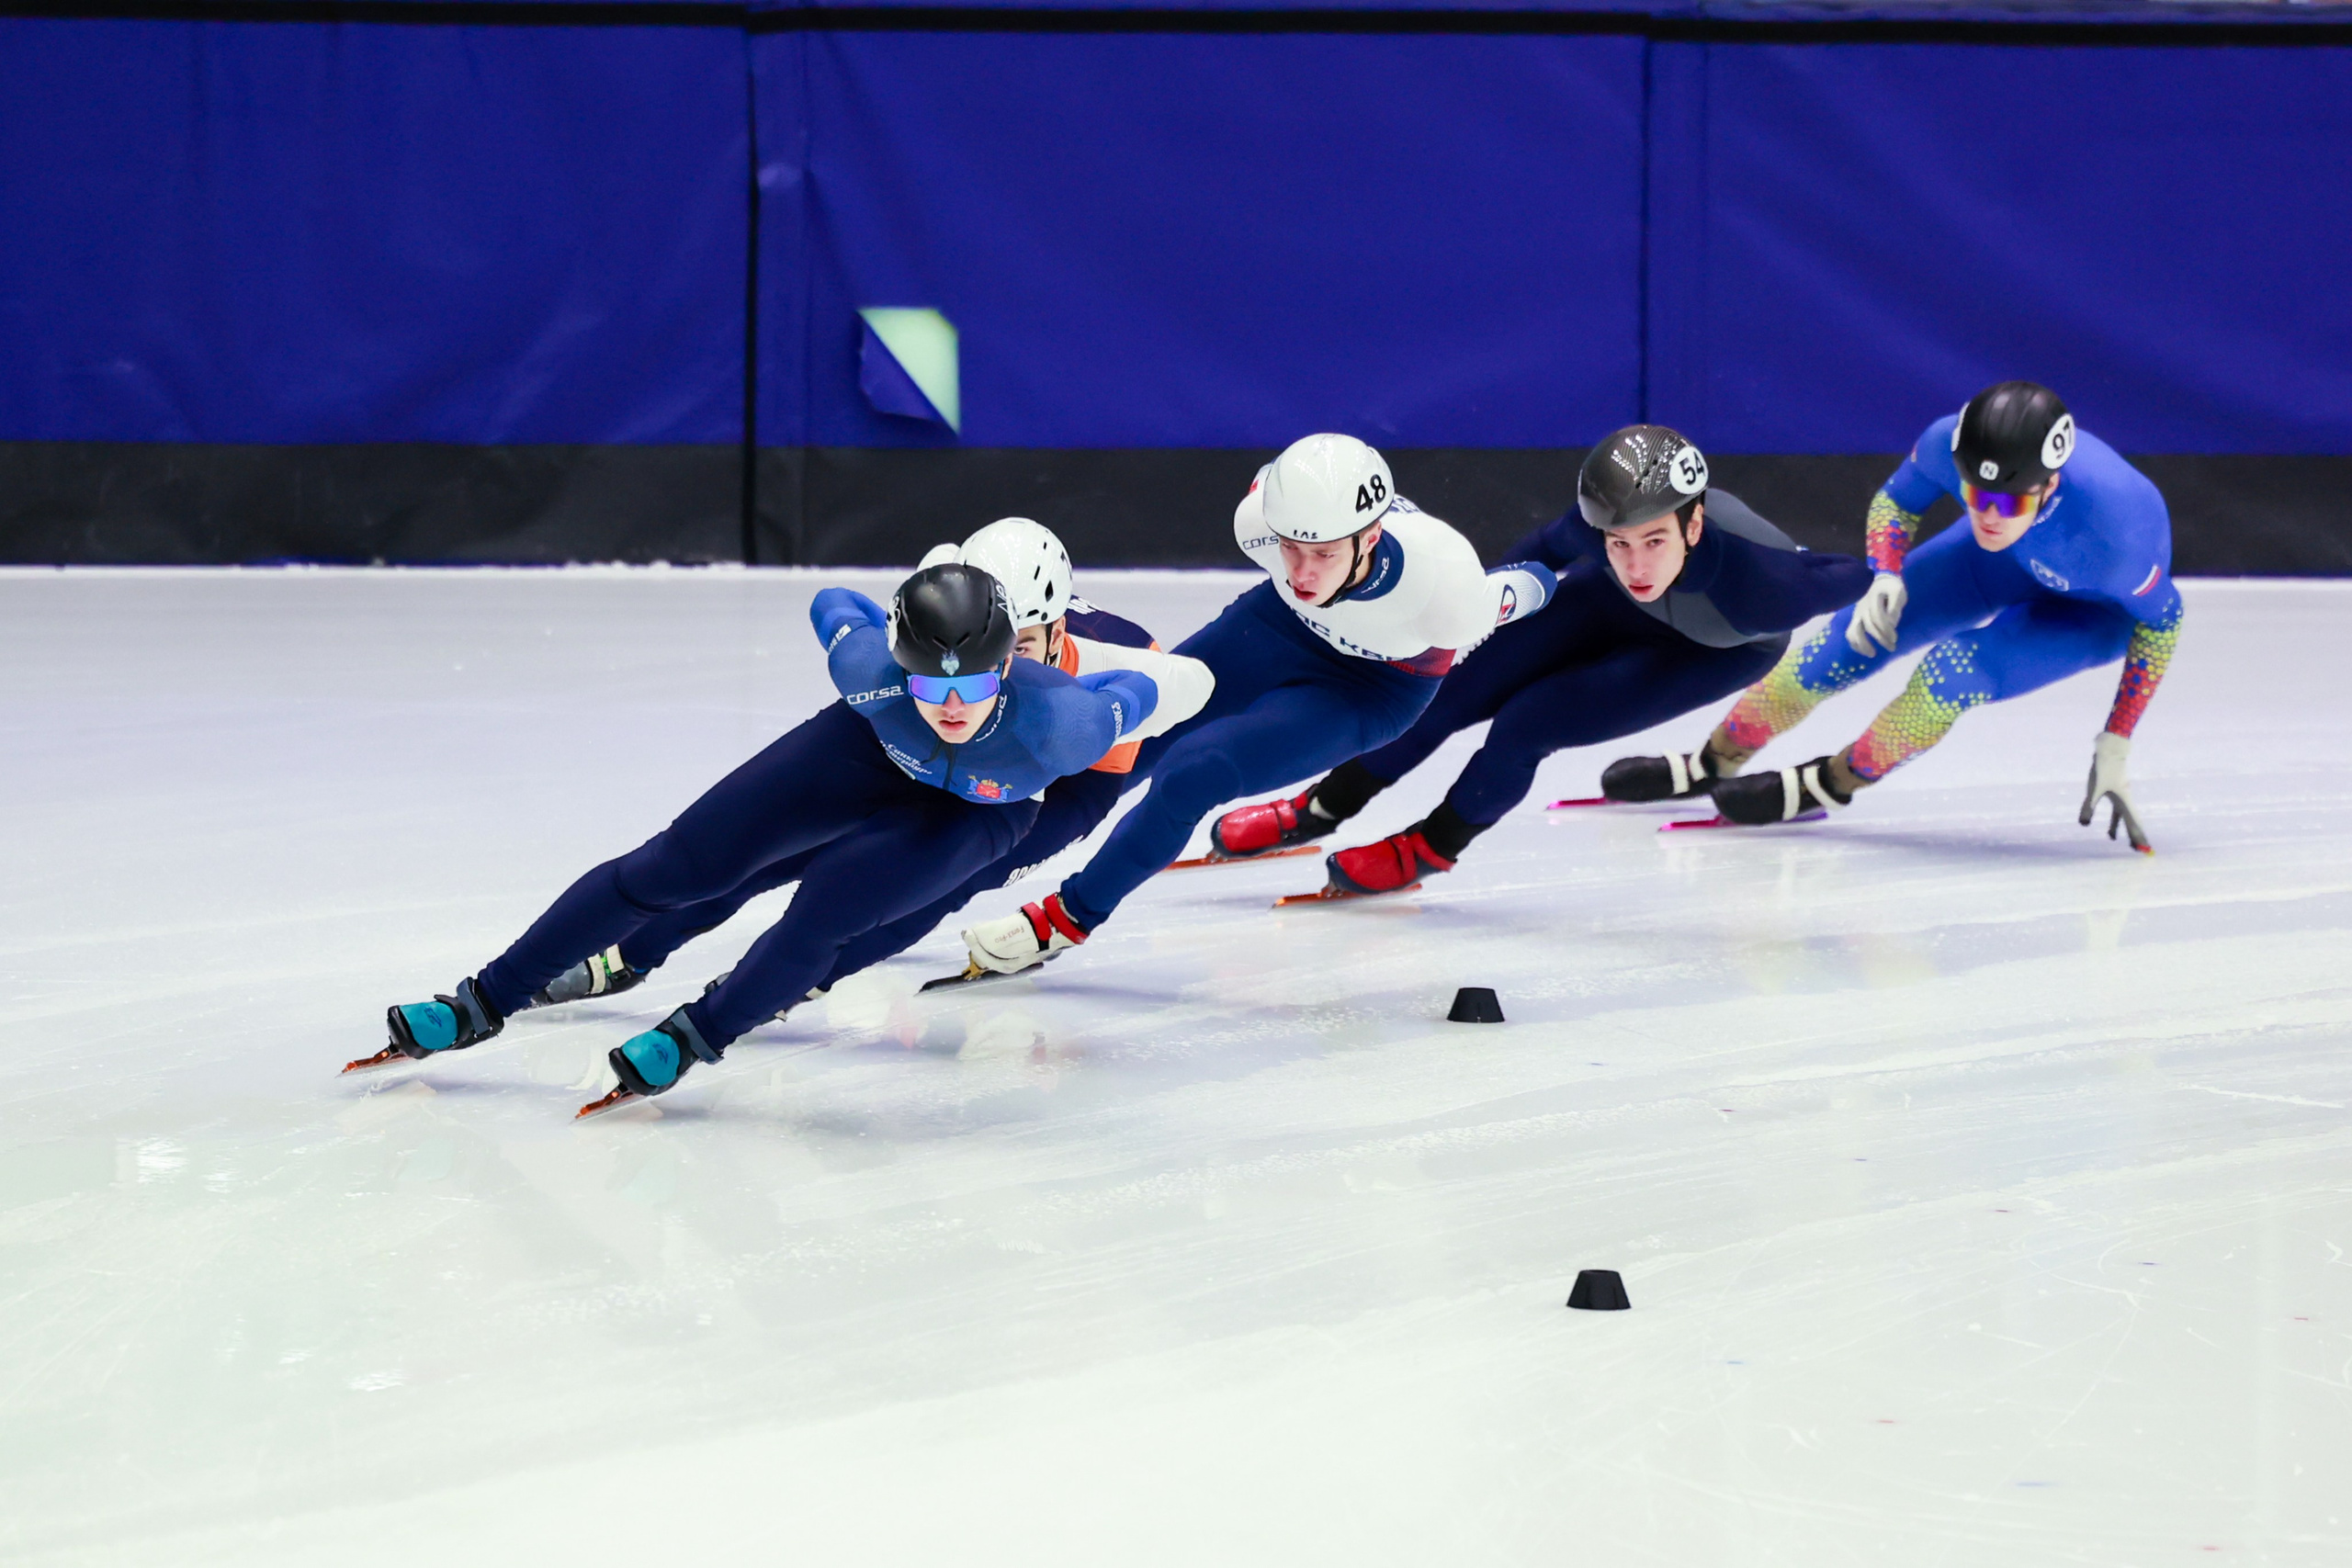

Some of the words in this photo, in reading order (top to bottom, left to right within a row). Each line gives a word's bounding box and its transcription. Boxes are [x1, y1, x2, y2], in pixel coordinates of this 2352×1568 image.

[1679, 451, 1705, 486] 54
[1355, 474, 1385, 513] 48
[1241, 536, 1280, 551] cors
[846, 685, 904, 705] corsa
